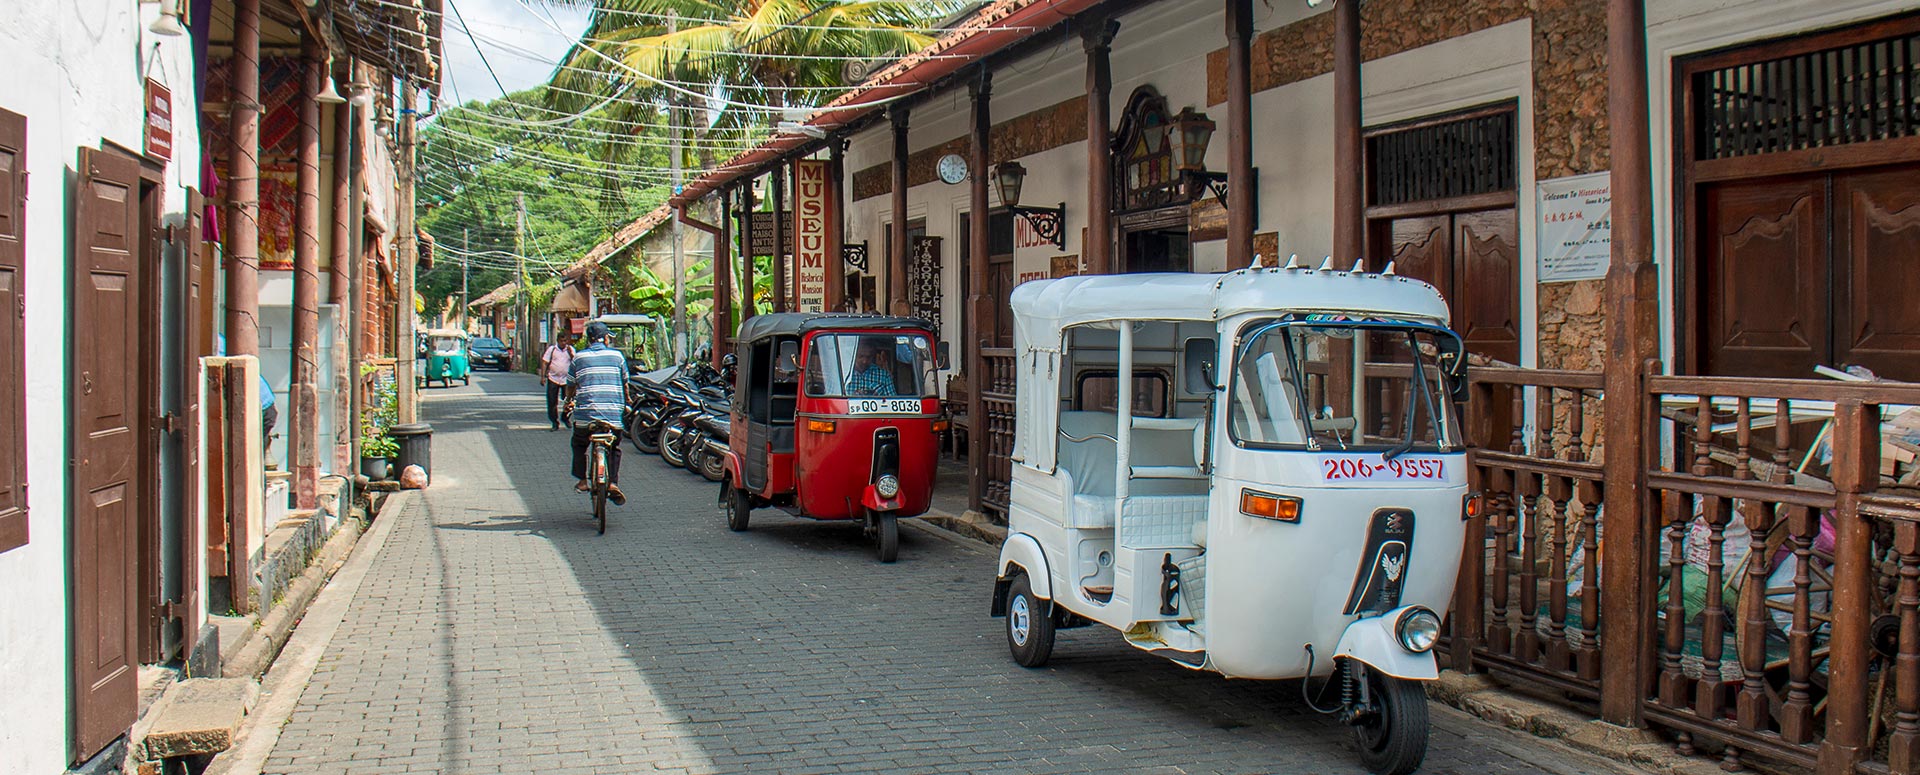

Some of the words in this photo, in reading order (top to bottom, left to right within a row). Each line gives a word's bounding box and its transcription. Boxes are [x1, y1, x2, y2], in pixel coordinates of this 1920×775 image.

[1570, 190, 1577, 198] To
[1578, 186, 1609, 197] Historical
[801, 165, 823, 268] MUSEUM
[801, 272, 823, 283] Historical
[921, 239, 932, 305] HISTORICAL
[801, 284, 823, 294] Mansion
[801, 297, 822, 305] ENTRANCE
[810, 305, 821, 313] FREE
[1323, 457, 1444, 480] 206-9557
